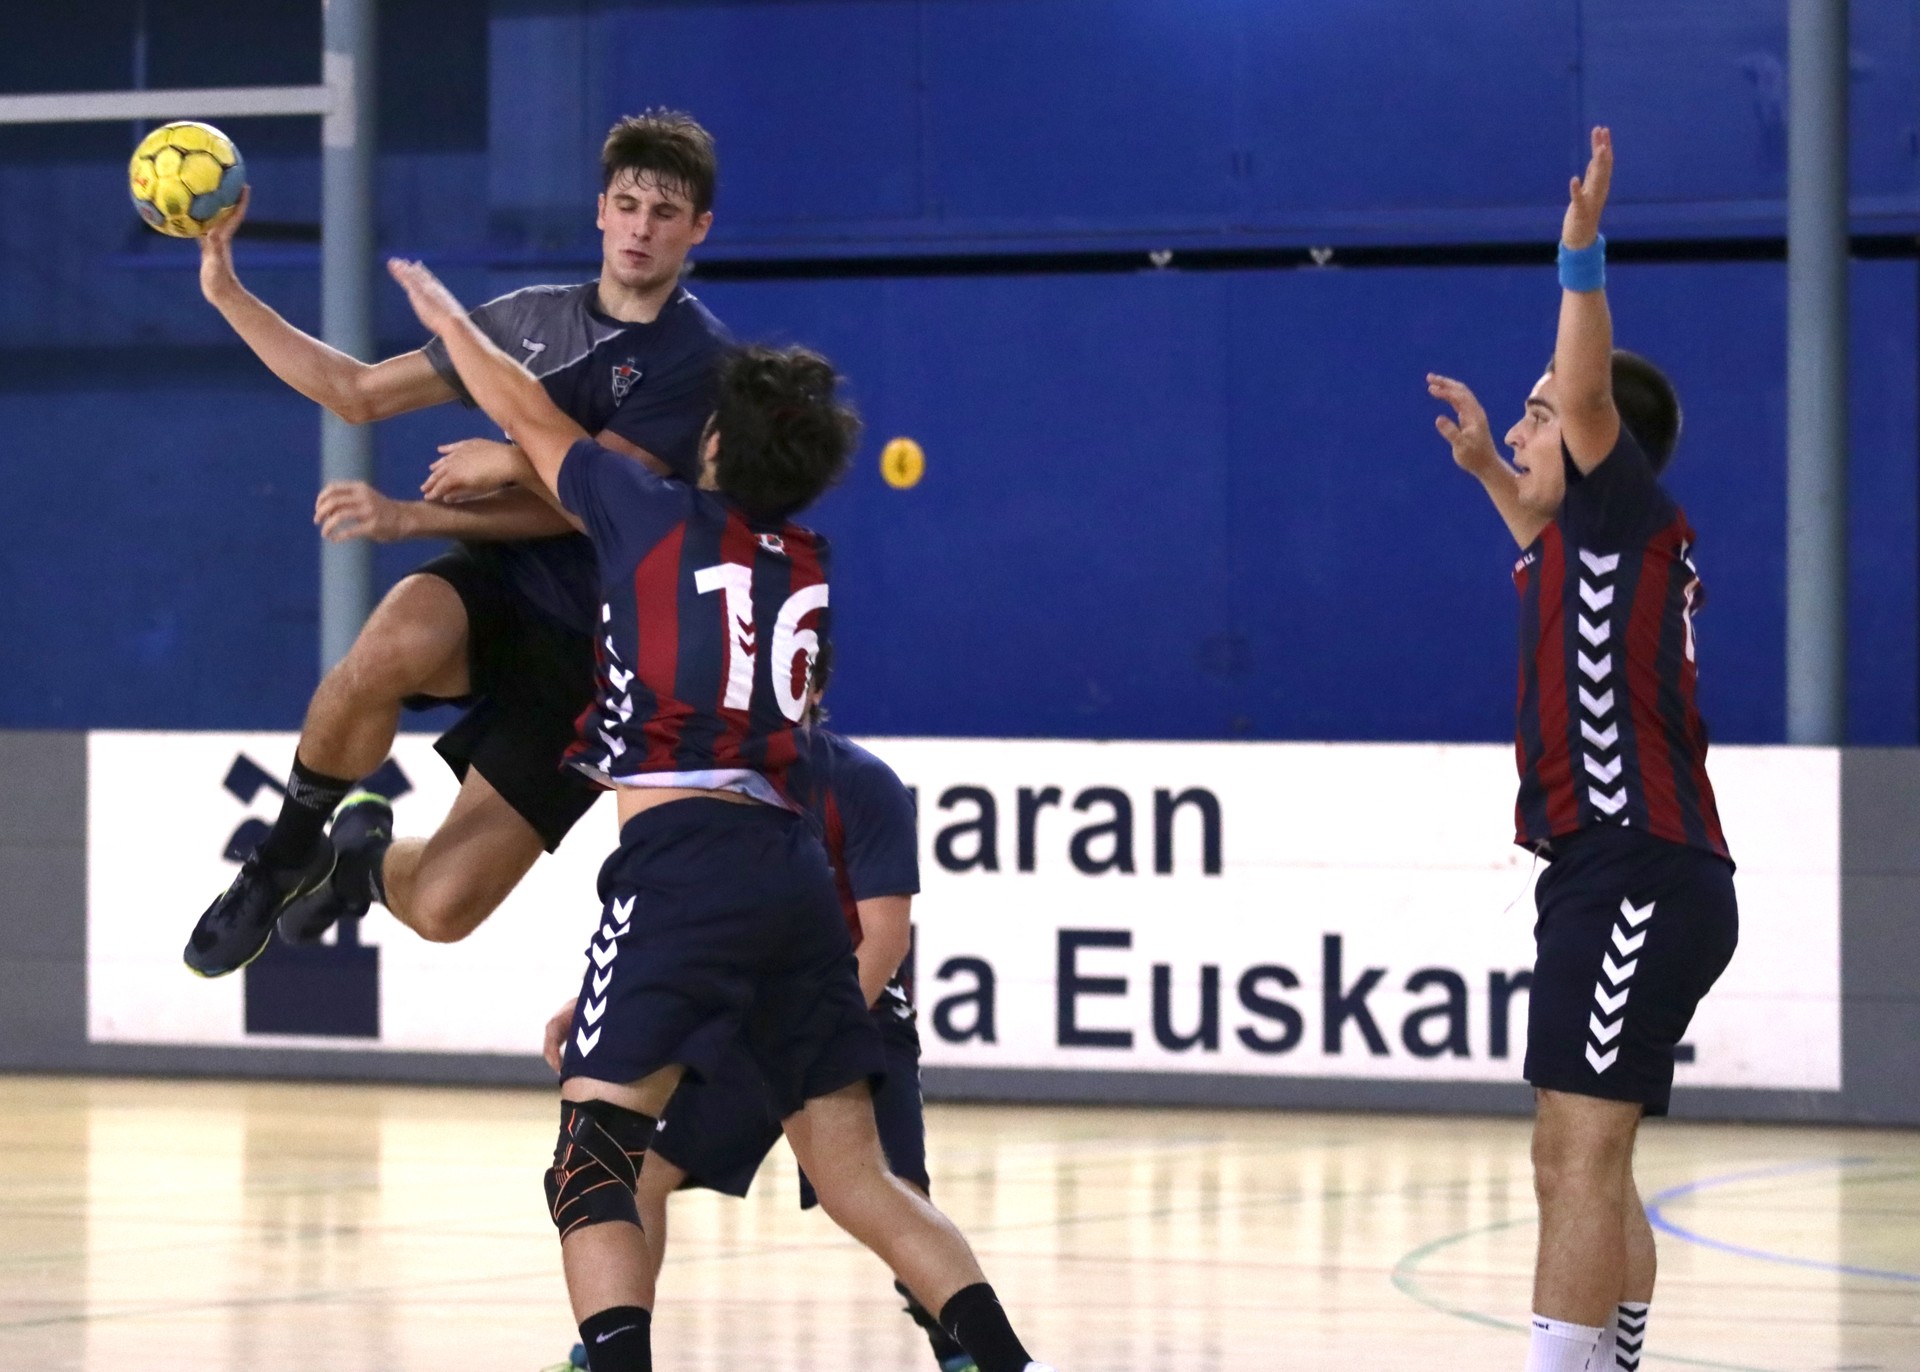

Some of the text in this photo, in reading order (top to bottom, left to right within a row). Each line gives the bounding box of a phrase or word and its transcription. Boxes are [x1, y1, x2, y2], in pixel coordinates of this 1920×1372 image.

[694, 562, 829, 722] 16
[907, 785, 1223, 876] aran
[1056, 928, 1695, 1062] Euskar
